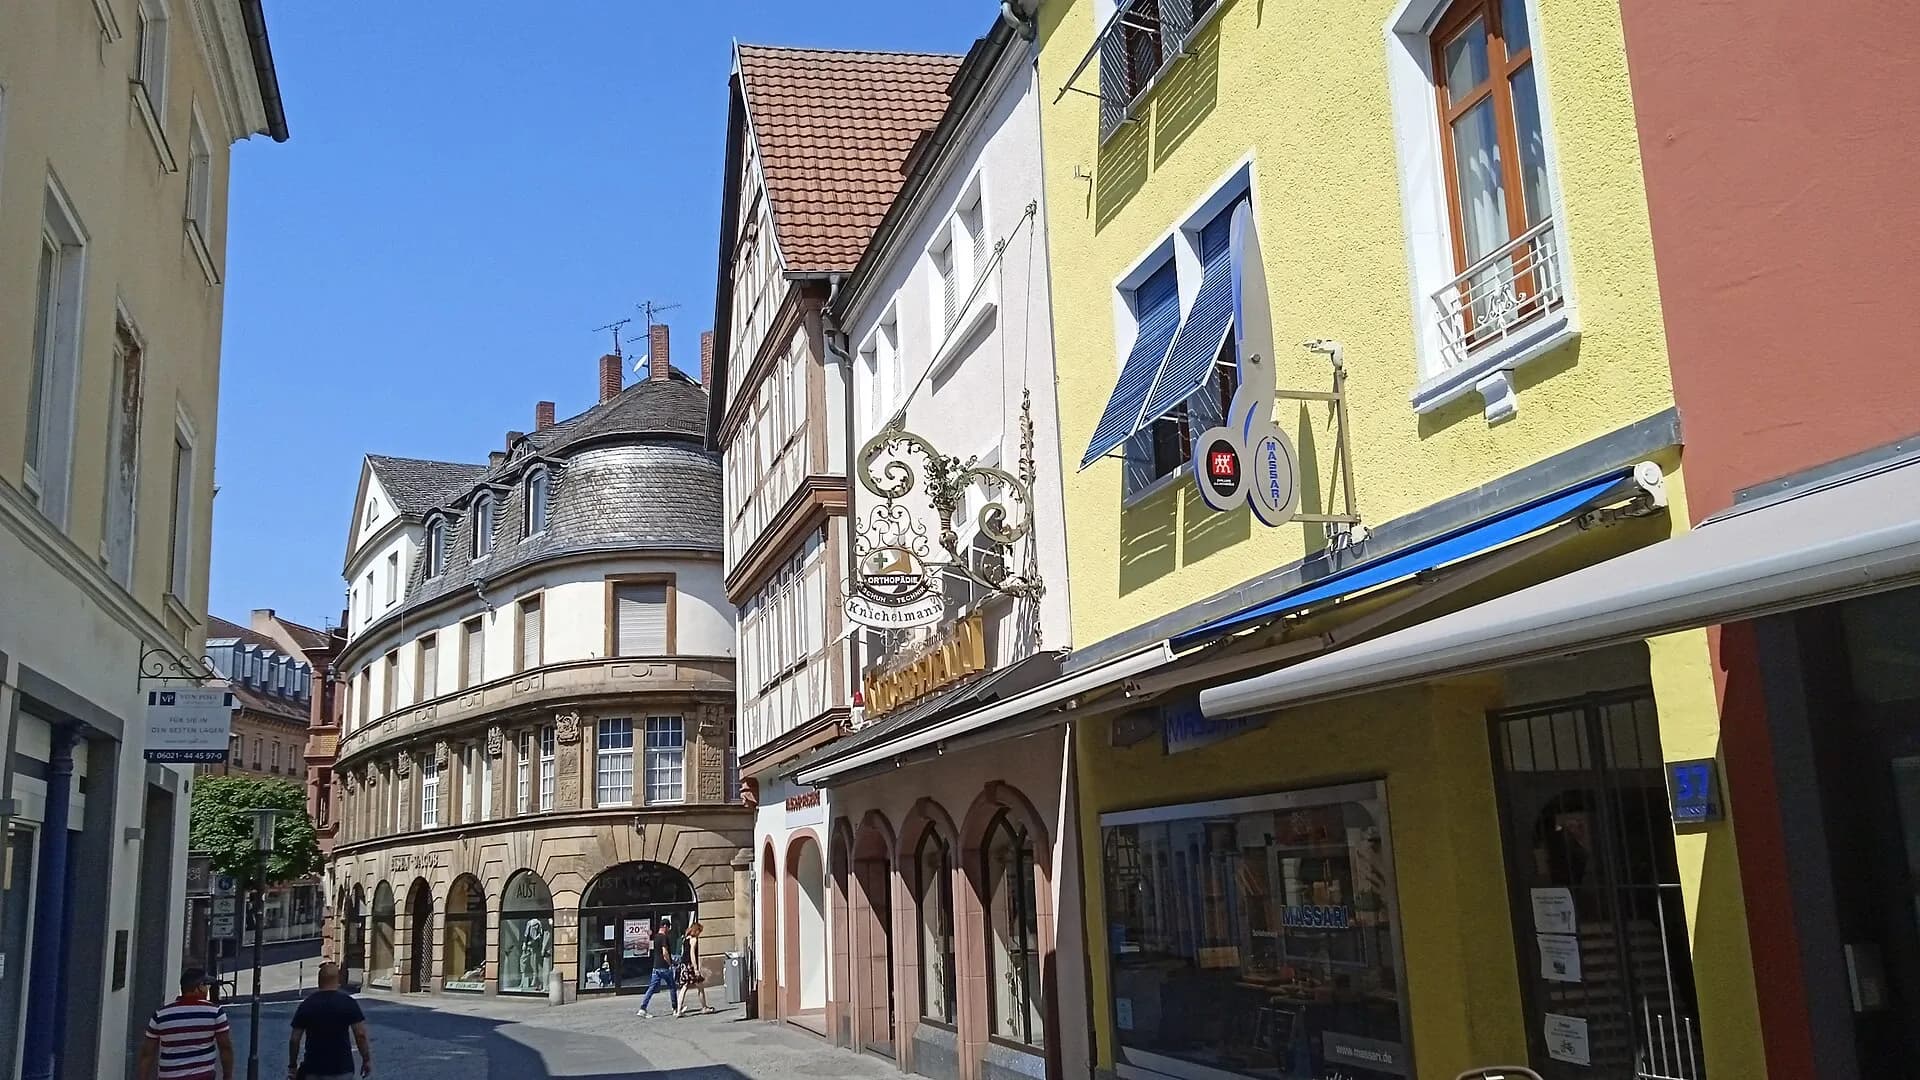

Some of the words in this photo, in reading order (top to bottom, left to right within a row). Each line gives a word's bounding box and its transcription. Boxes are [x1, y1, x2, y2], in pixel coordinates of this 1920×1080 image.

[1266, 441, 1280, 508] MASSARI
[867, 575, 918, 585] ORTHOPÄDIE
[861, 588, 887, 603] SCHUH
[896, 586, 926, 603] TECHNIK
[848, 600, 943, 622] Knichelmann
[516, 882, 537, 899] AUST
[1280, 904, 1350, 929] MASSARI
